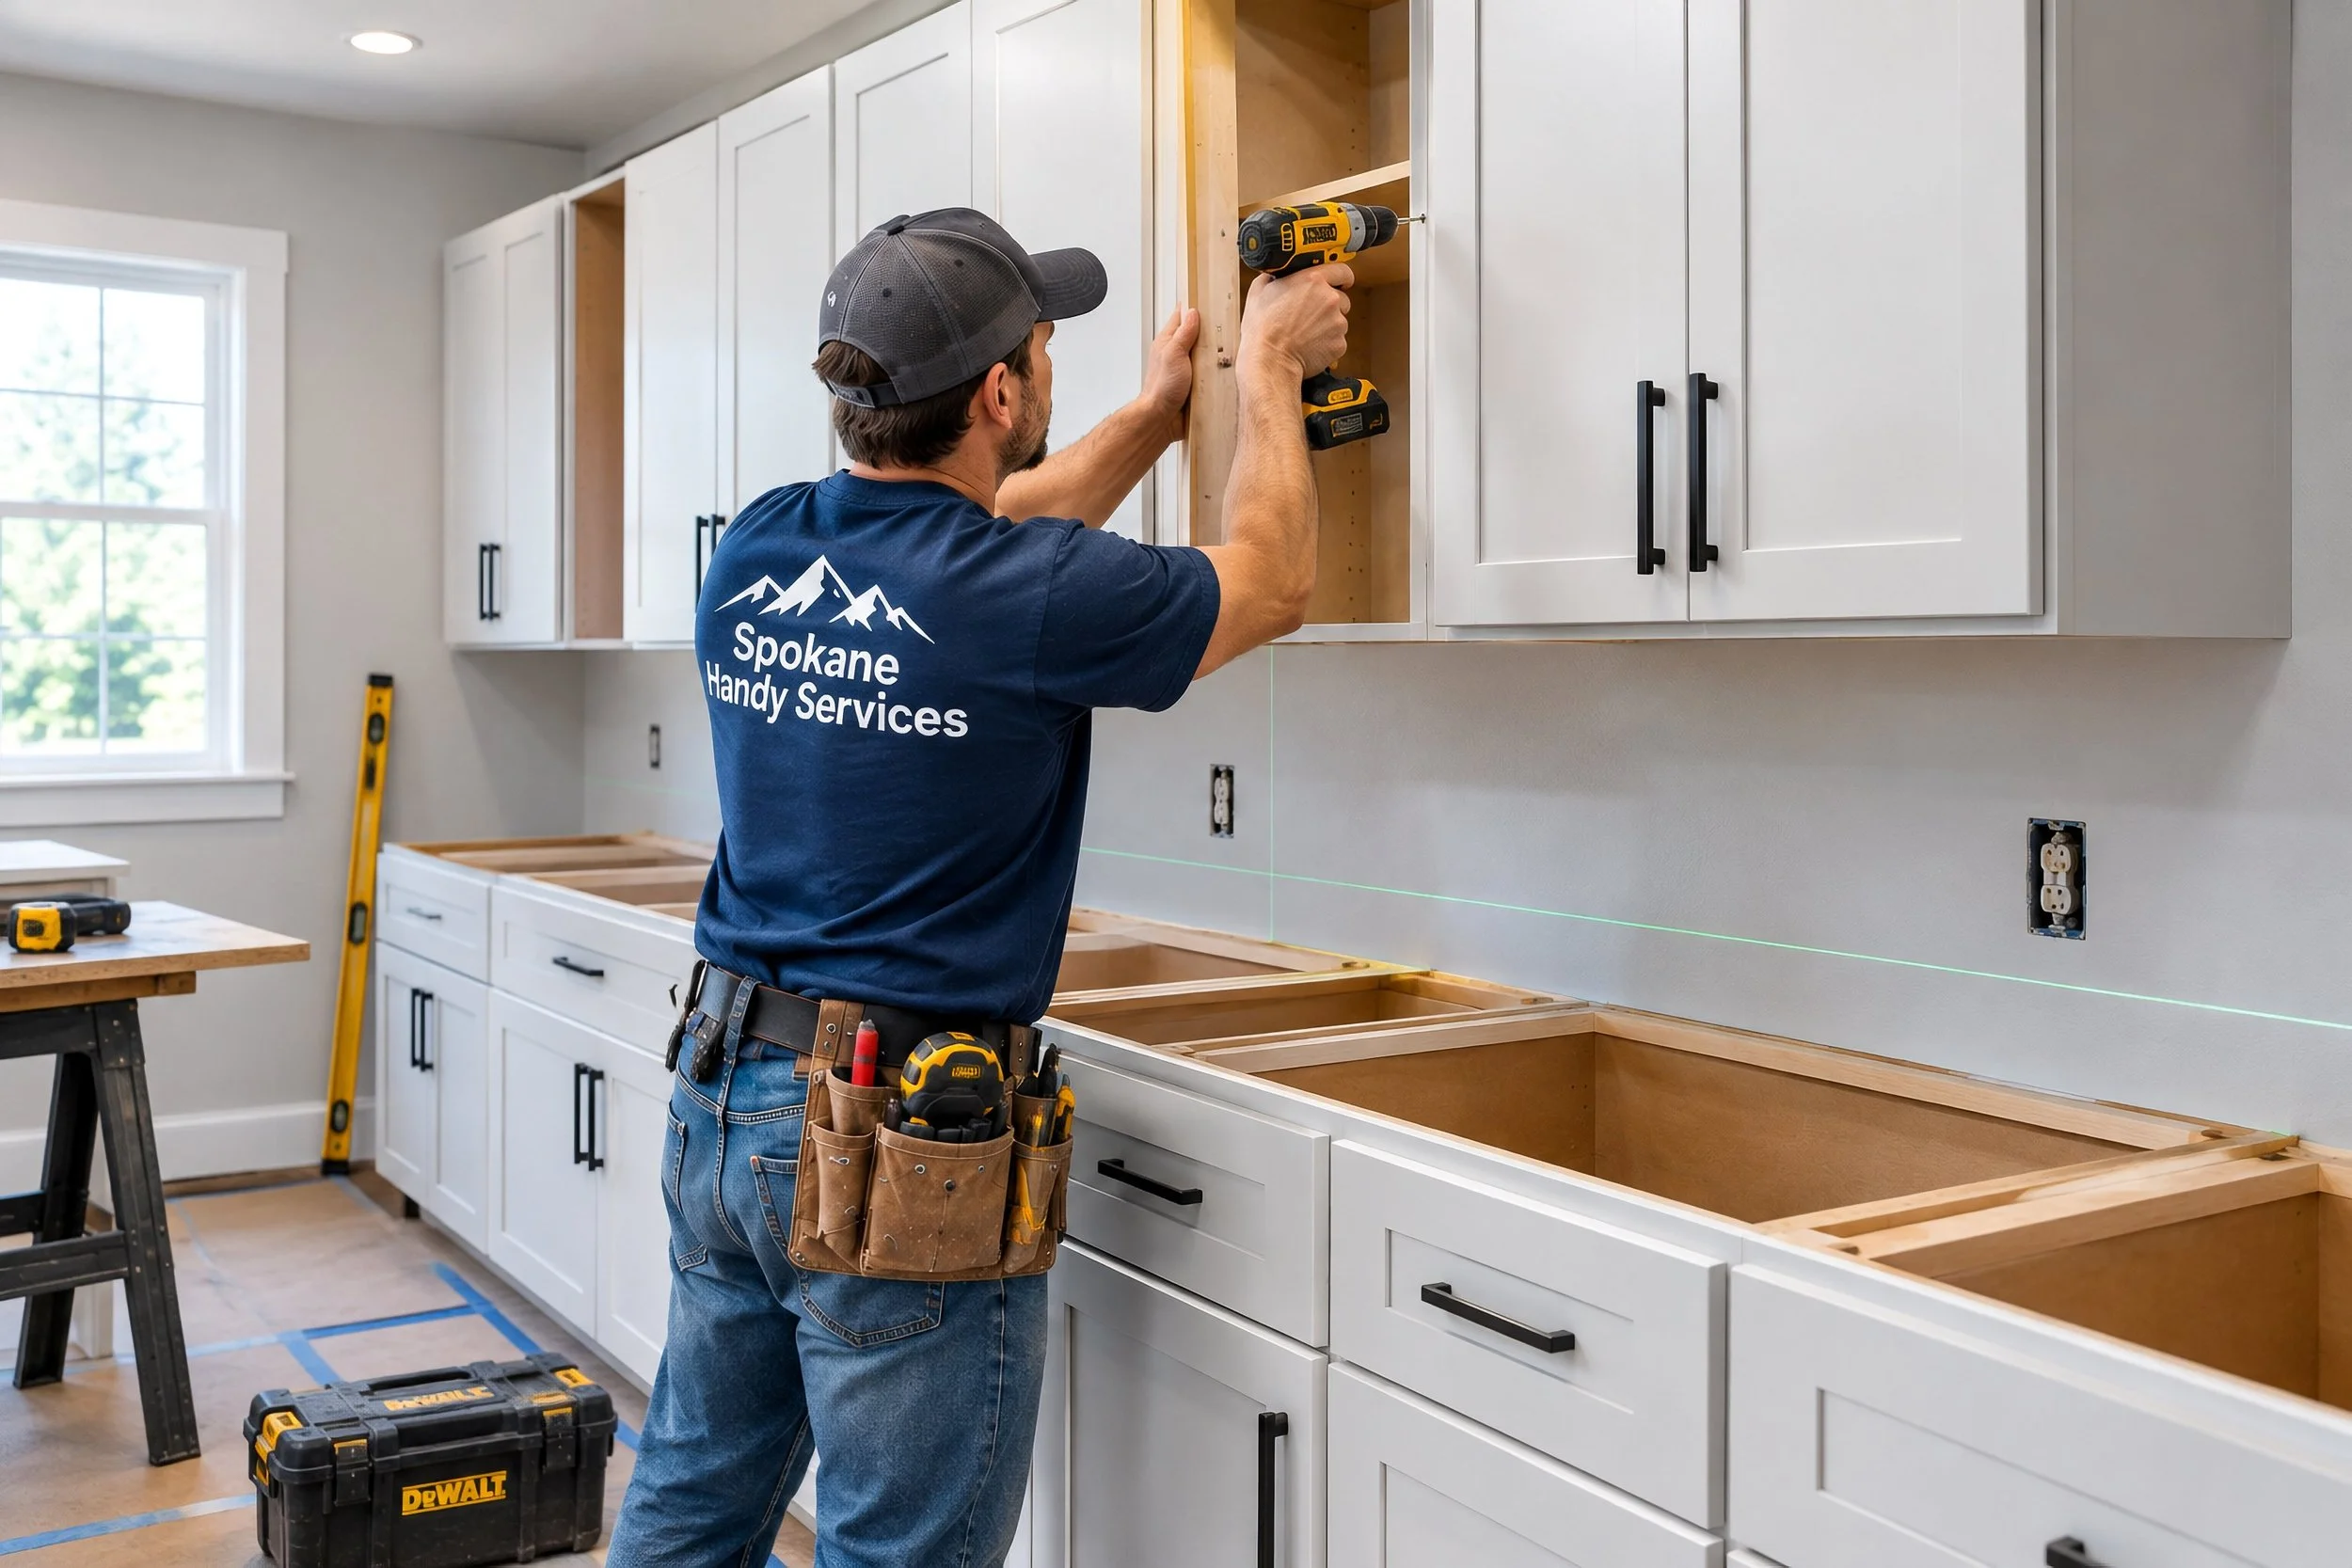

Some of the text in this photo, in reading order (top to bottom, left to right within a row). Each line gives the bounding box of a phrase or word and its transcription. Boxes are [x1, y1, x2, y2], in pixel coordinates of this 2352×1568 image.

[733, 622, 899, 686] Spokane
[706, 660, 969, 737] Handy Services
